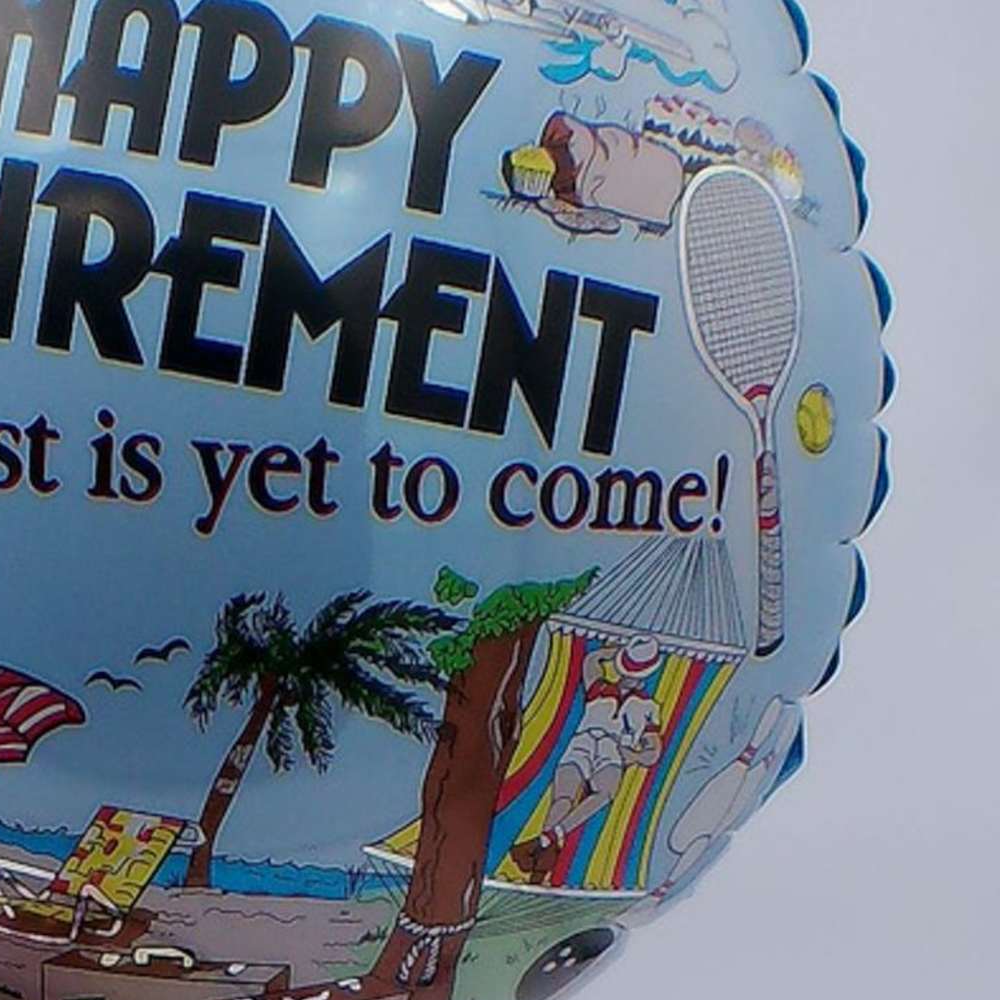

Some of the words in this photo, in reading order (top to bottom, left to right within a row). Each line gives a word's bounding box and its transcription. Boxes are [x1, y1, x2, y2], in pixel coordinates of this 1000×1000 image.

[86, 408, 163, 500] is
[190, 435, 341, 535] yet
[371, 440, 460, 523] to
[489, 454, 730, 534] come!
